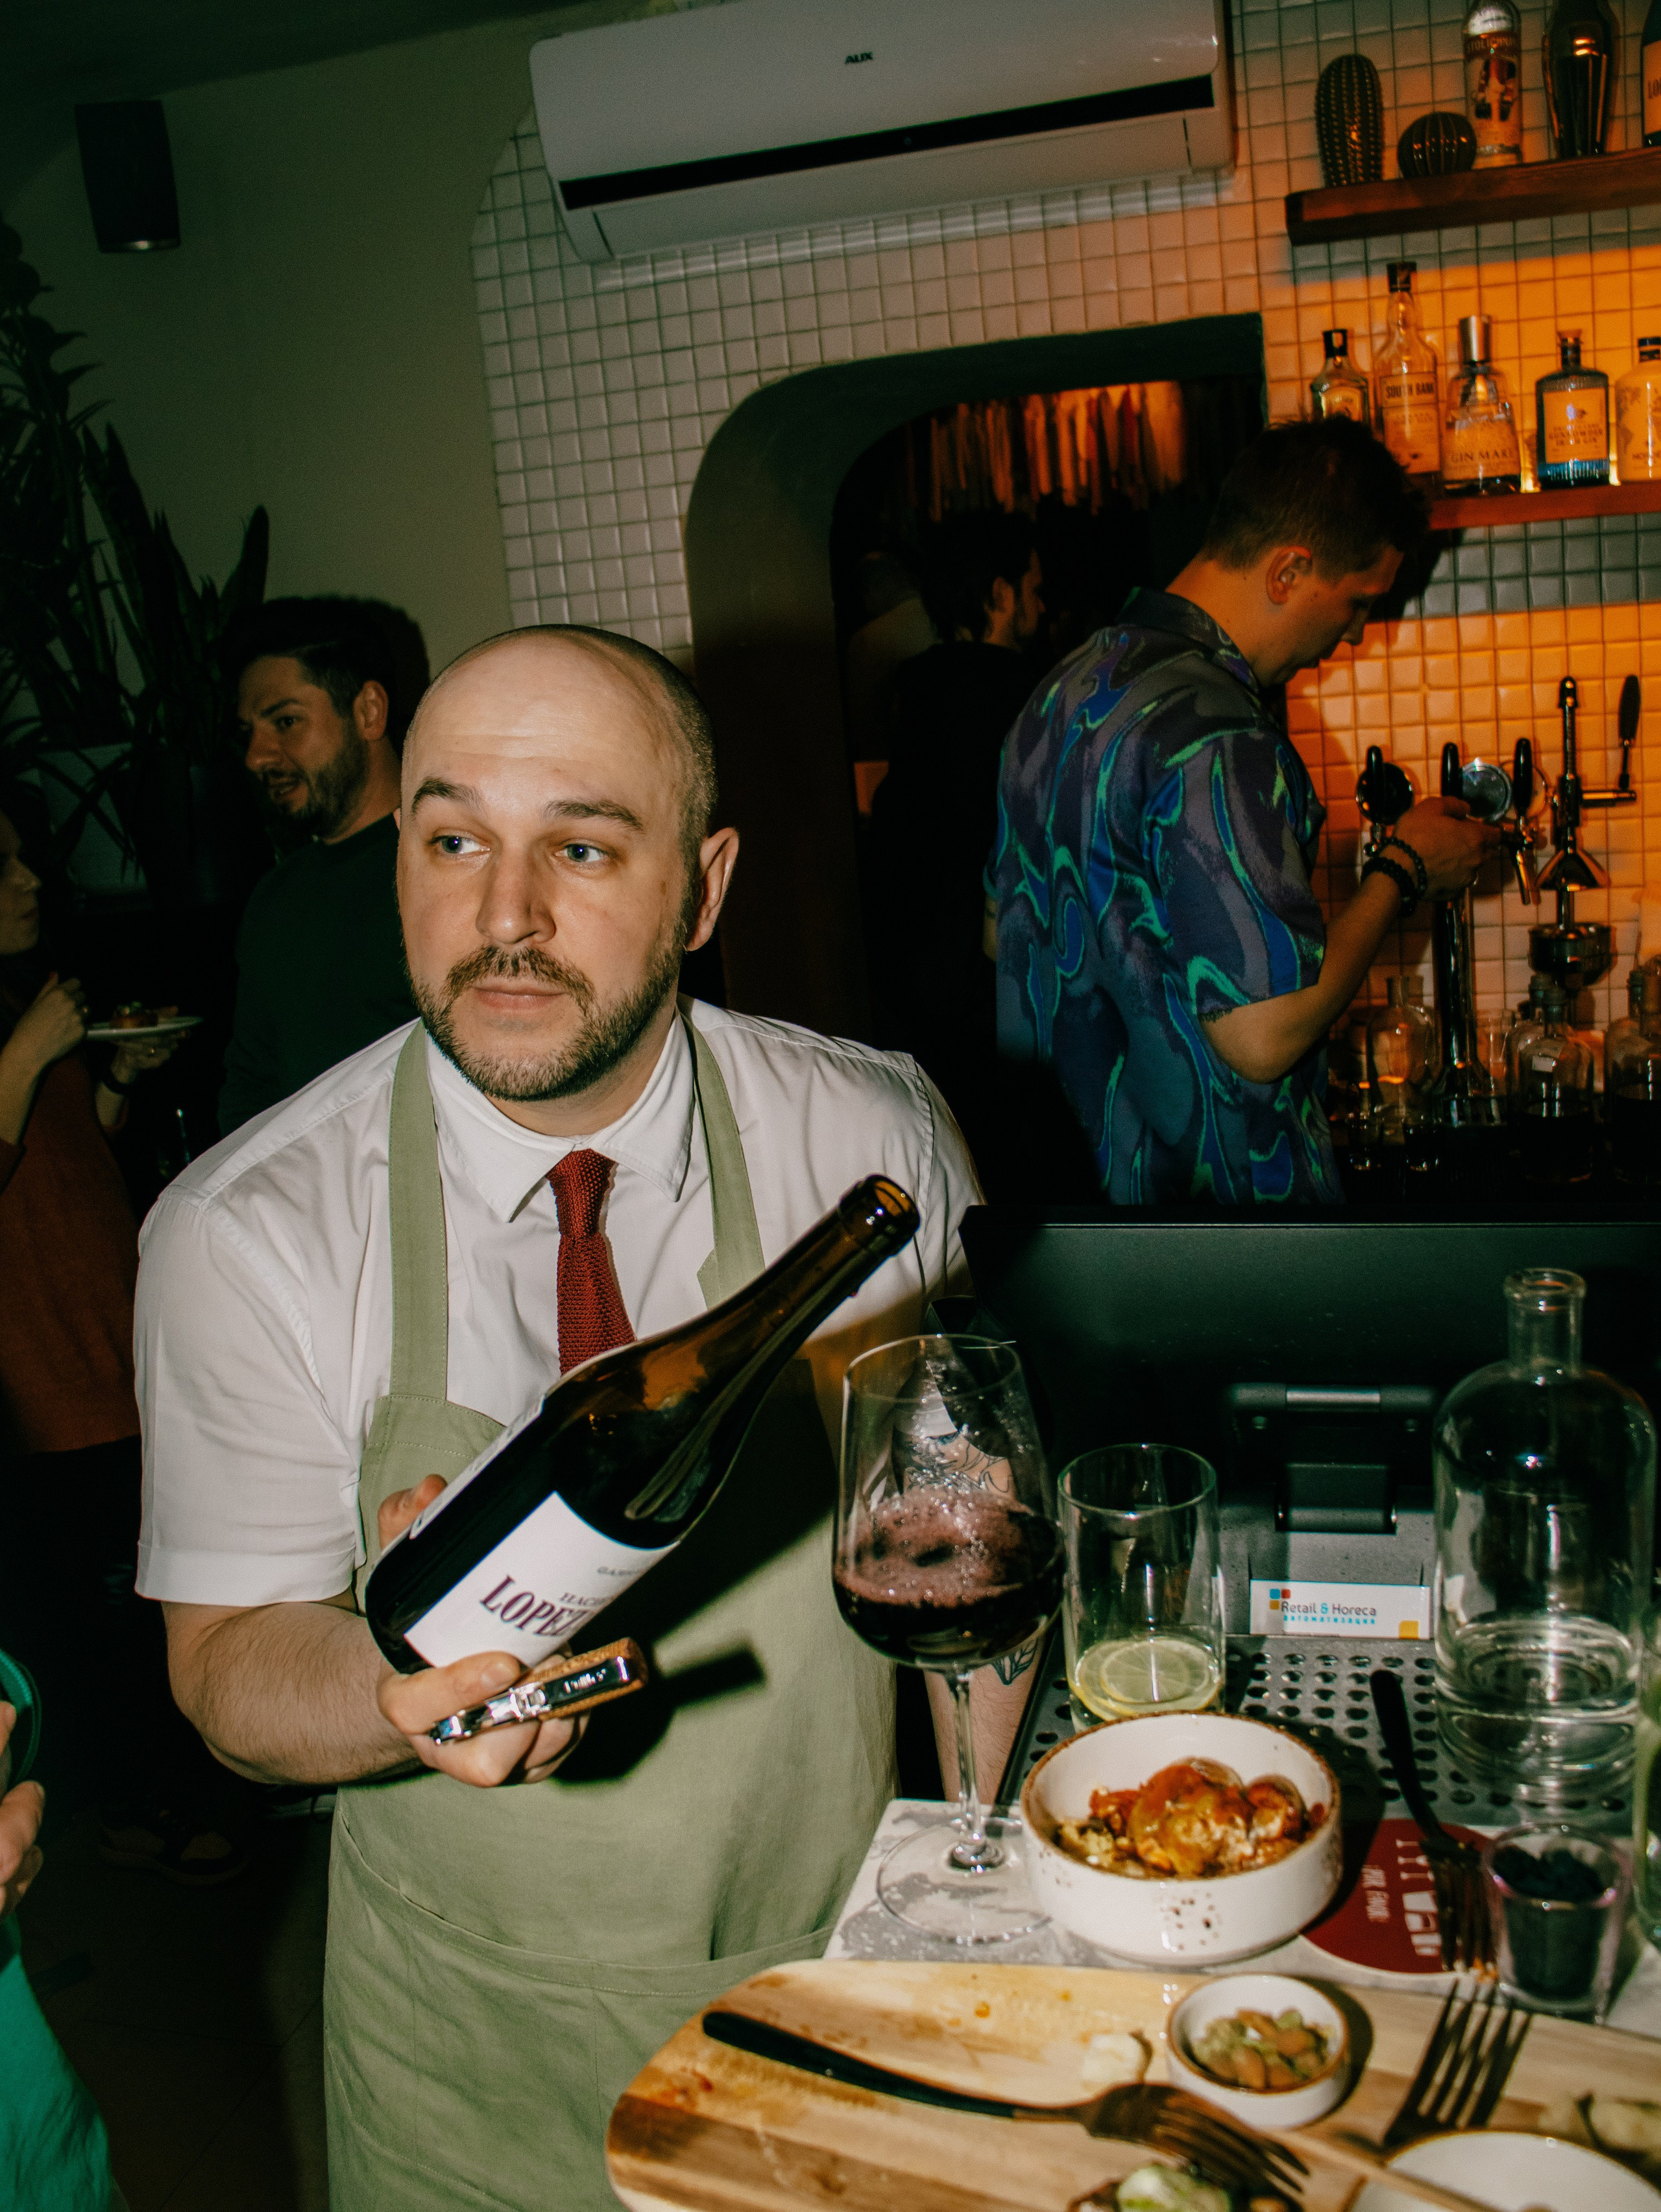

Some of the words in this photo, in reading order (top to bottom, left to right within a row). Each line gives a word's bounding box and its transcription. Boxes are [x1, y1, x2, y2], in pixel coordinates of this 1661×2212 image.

[845, 51, 873, 64] AUX
[479, 1574, 588, 1637] LOPEZ
[1281, 1600, 1317, 1614] Retail
[1320, 1602, 1329, 1615] &
[1332, 1602, 1377, 1617] Horeca
